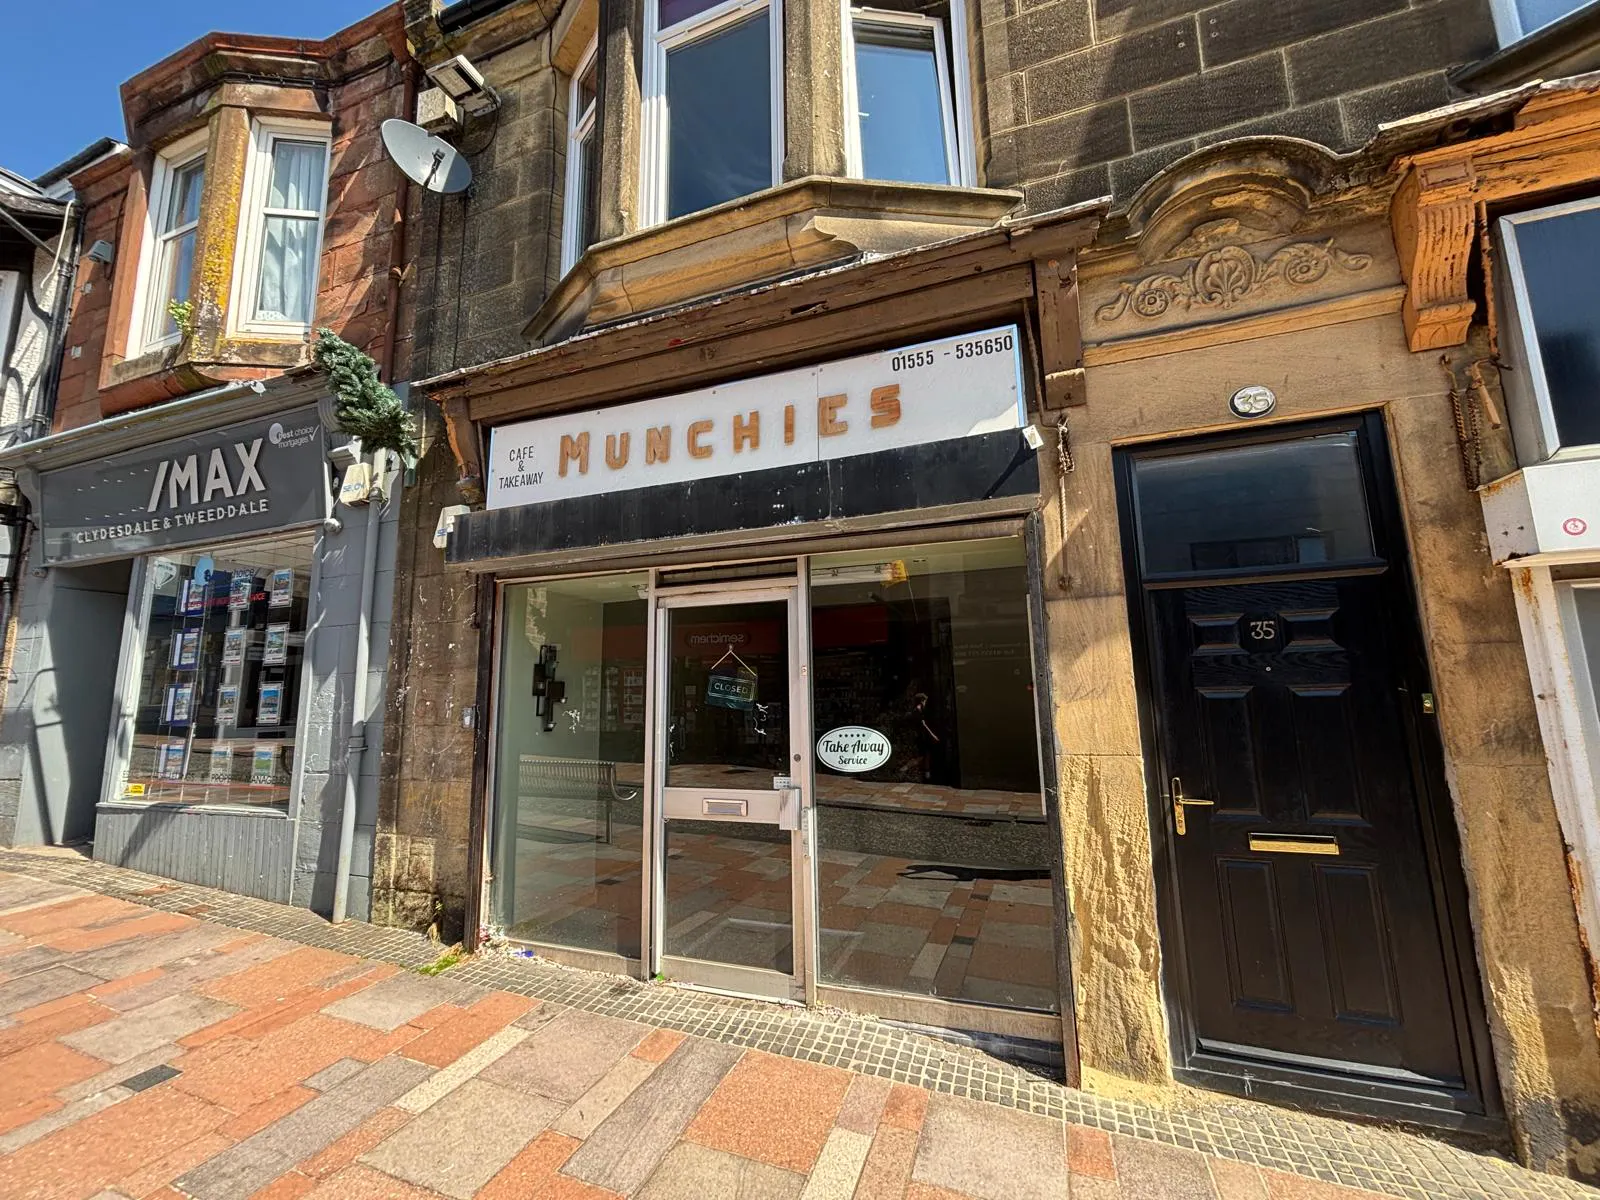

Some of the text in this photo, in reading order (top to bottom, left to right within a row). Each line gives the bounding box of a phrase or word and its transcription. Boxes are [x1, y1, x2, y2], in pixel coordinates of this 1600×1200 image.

[892, 350, 934, 371] 01555
[955, 335, 1013, 359] 535650
[1237, 391, 1270, 412] 35
[558, 383, 901, 478] MUNCHIES
[278, 436, 309, 448] mortgages
[509, 445, 534, 461] CAFE
[517, 460, 525, 472] &
[499, 472, 544, 489] TAKEAWAY
[76, 499, 269, 544] CLYDESDALE & TWEEDDALE
[1250, 620, 1275, 640] 35
[714, 682, 749, 694] CLOSED
[823, 739, 884, 756] Take Away
[838, 756, 868, 765] Service
